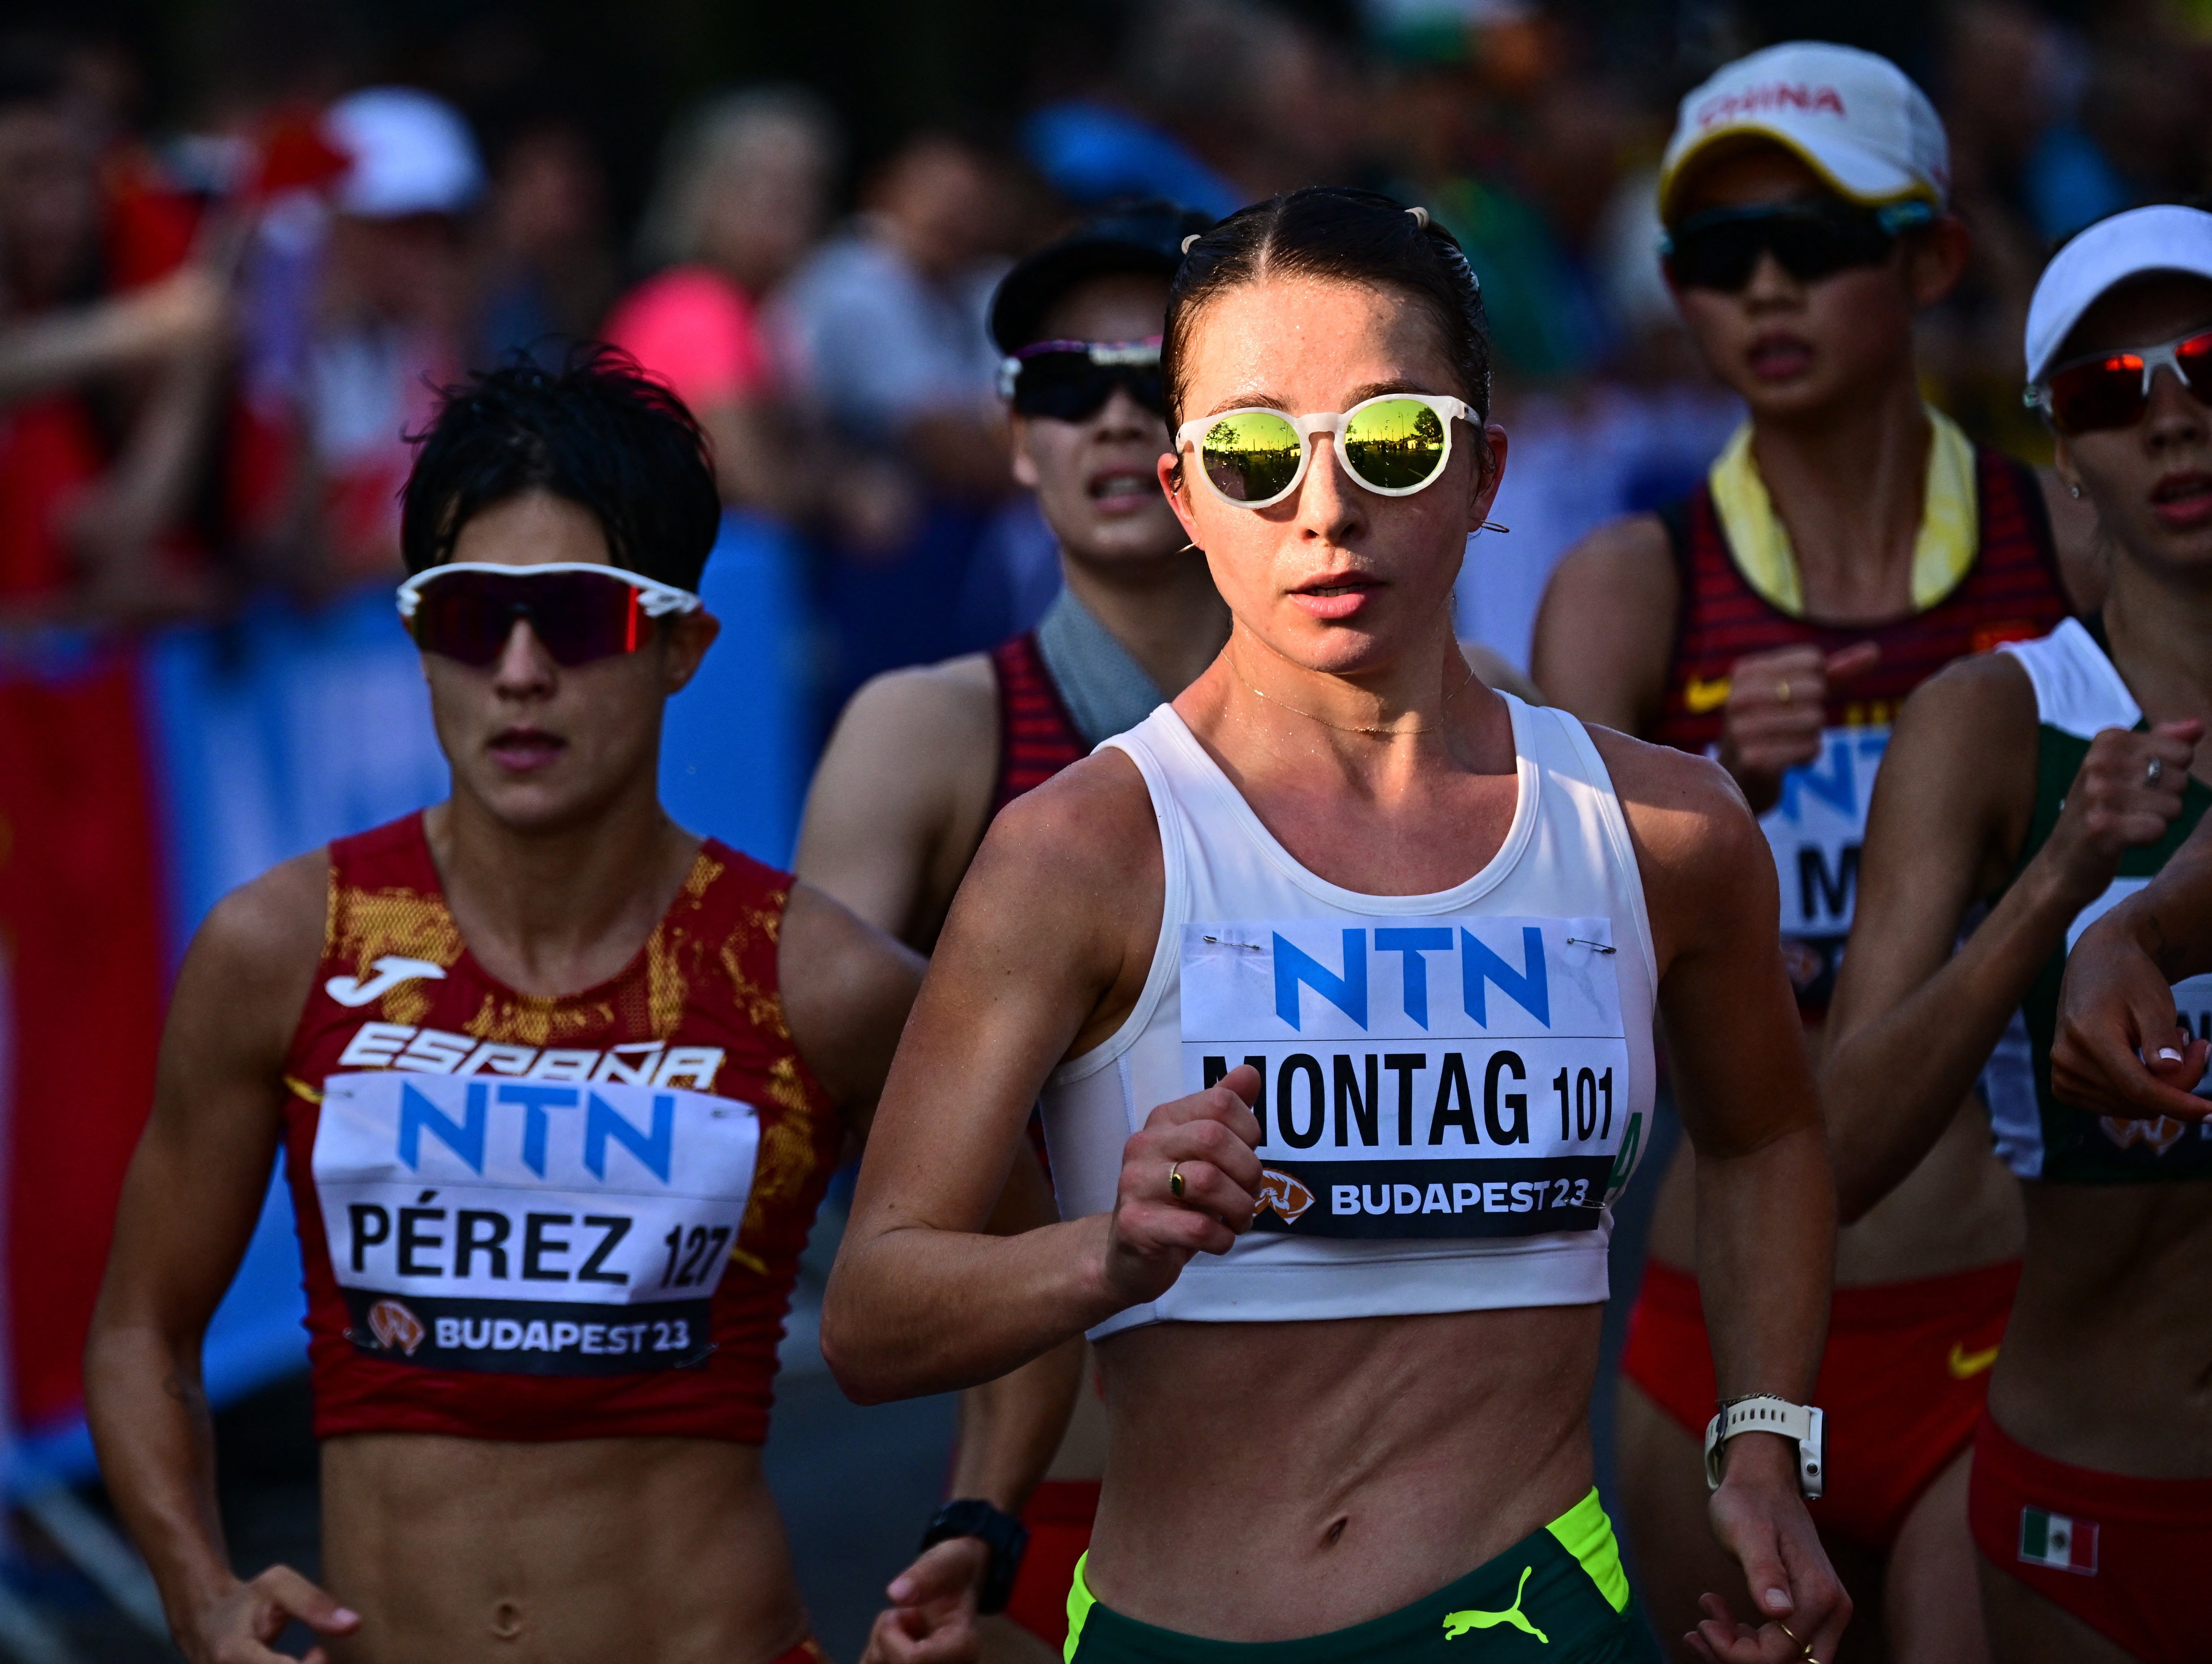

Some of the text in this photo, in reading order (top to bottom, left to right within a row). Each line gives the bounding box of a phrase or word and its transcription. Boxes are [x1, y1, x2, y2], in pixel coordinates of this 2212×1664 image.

[1272, 926, 1550, 1032] NTN
[338, 1022, 726, 1089] ESPAÑA
[1553, 1067, 1612, 1141] 101
[397, 1080, 675, 1185] NTN
[348, 1190, 731, 1288] PÉREZ 127
